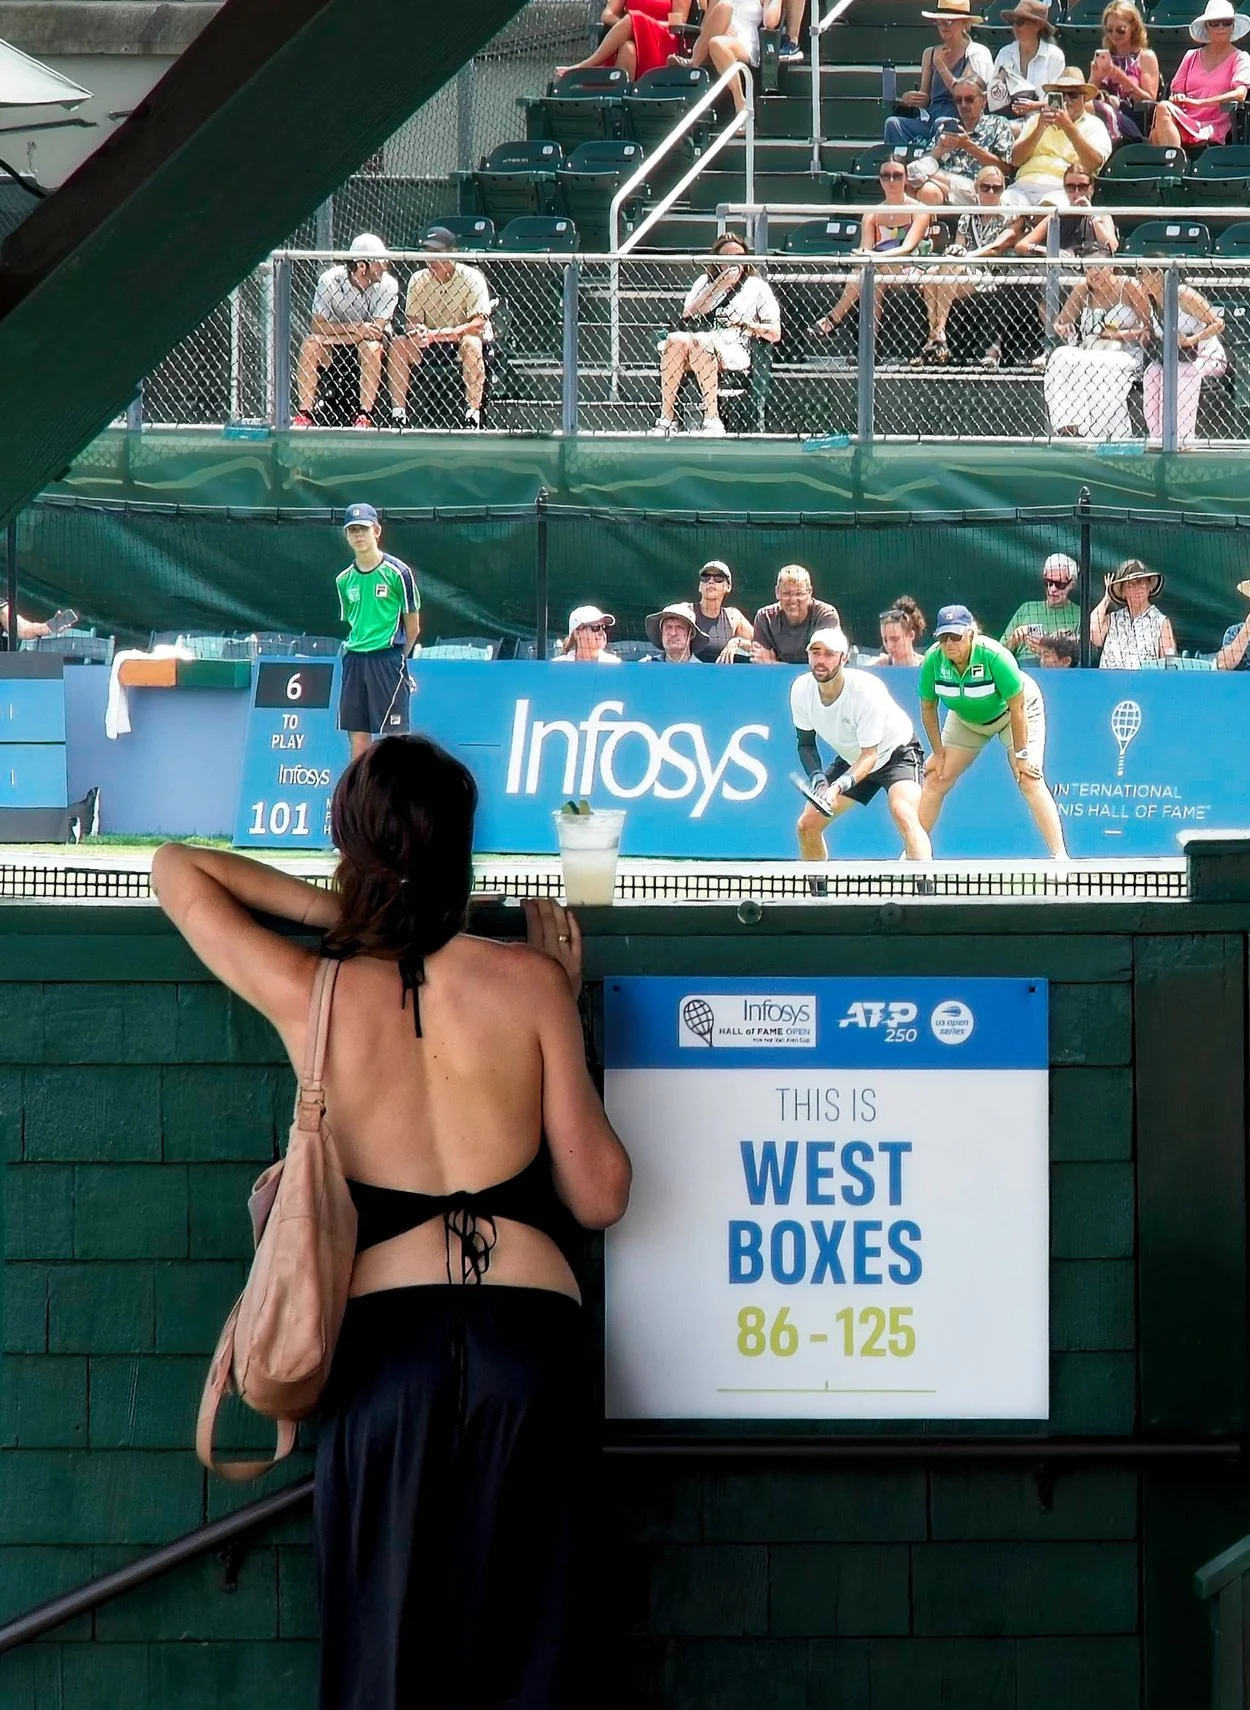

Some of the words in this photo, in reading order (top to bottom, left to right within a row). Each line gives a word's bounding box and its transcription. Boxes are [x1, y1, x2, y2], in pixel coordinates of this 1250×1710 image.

[286, 672, 302, 700] 6
[282, 713, 299, 730] TO
[271, 733, 305, 750] PLAY
[506, 699, 768, 817] Infosys
[278, 764, 331, 788] Infosys
[1053, 783, 1182, 799] INTERNATIONAL
[248, 801, 309, 835] 101
[1057, 803, 1083, 818] NIS
[1088, 804, 1129, 818] HALL
[1135, 804, 1158, 818] OF
[744, 999, 810, 1026] Infosys
[838, 1002, 918, 1028] ATP
[718, 1027, 743, 1036] HALL
[745, 1027, 755, 1036] of
[757, 1027, 783, 1036] FAME
[785, 1027, 811, 1036] OPEN
[884, 1028, 918, 1043] 250
[775, 1087, 840, 1122] THIS
[852, 1088, 877, 1123] IS
[739, 1140, 913, 1207] WEST
[728, 1219, 923, 1286] BOXES
[735, 1305, 799, 1358] 86
[835, 1306, 916, 1358] 125
